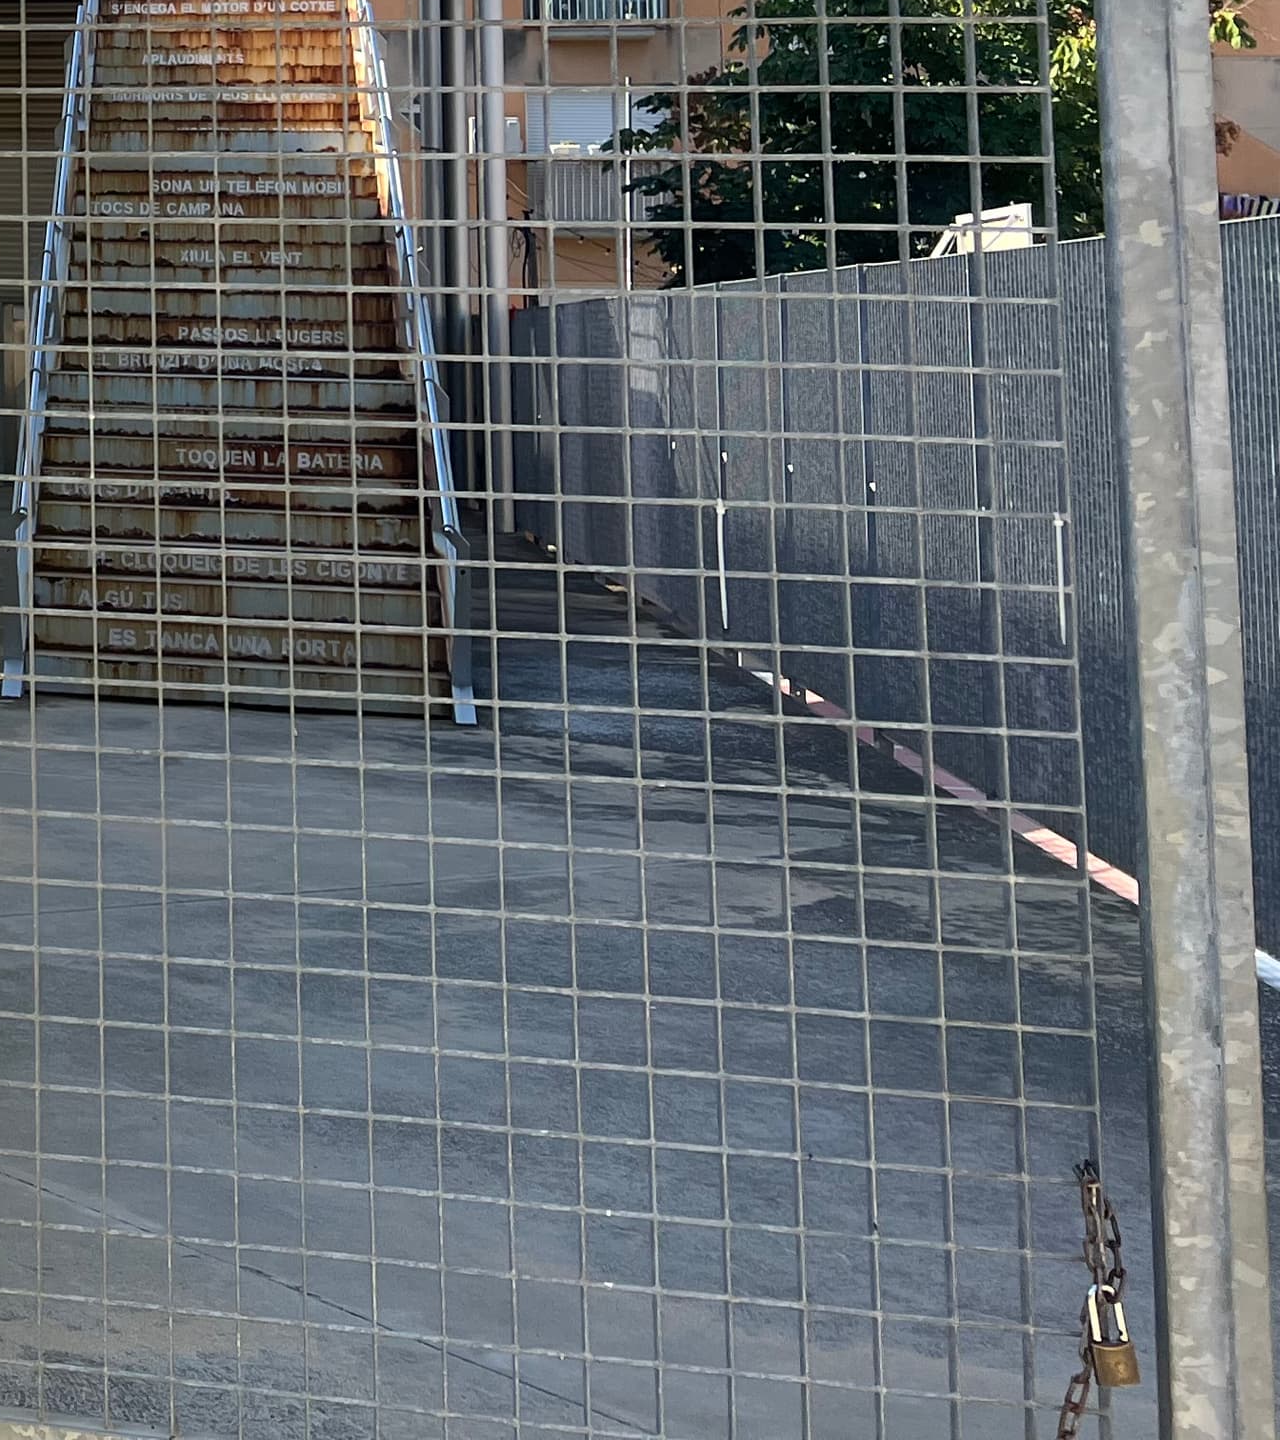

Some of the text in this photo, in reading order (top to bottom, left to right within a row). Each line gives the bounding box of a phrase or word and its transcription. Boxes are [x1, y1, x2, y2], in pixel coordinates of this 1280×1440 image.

[181, 1, 196, 14] EL
[202, 1, 248, 13] MOTOR
[290, 0, 336, 12] COTXE
[152, 179, 192, 193] SONA
[225, 176, 297, 194] TELÈFON
[90, 201, 245, 216] TOCS DE CAMPANA
[232, 250, 253, 264] EL
[260, 251, 303, 265] VENT
[178, 326, 249, 343] PASSOS
[176, 448, 384, 471] TOQUEN LA BATERIA
[232, 557, 260, 574] DE
[108, 627, 137, 646] ES
[145, 629, 220, 652] TANCA
[228, 634, 273, 656] UNA
